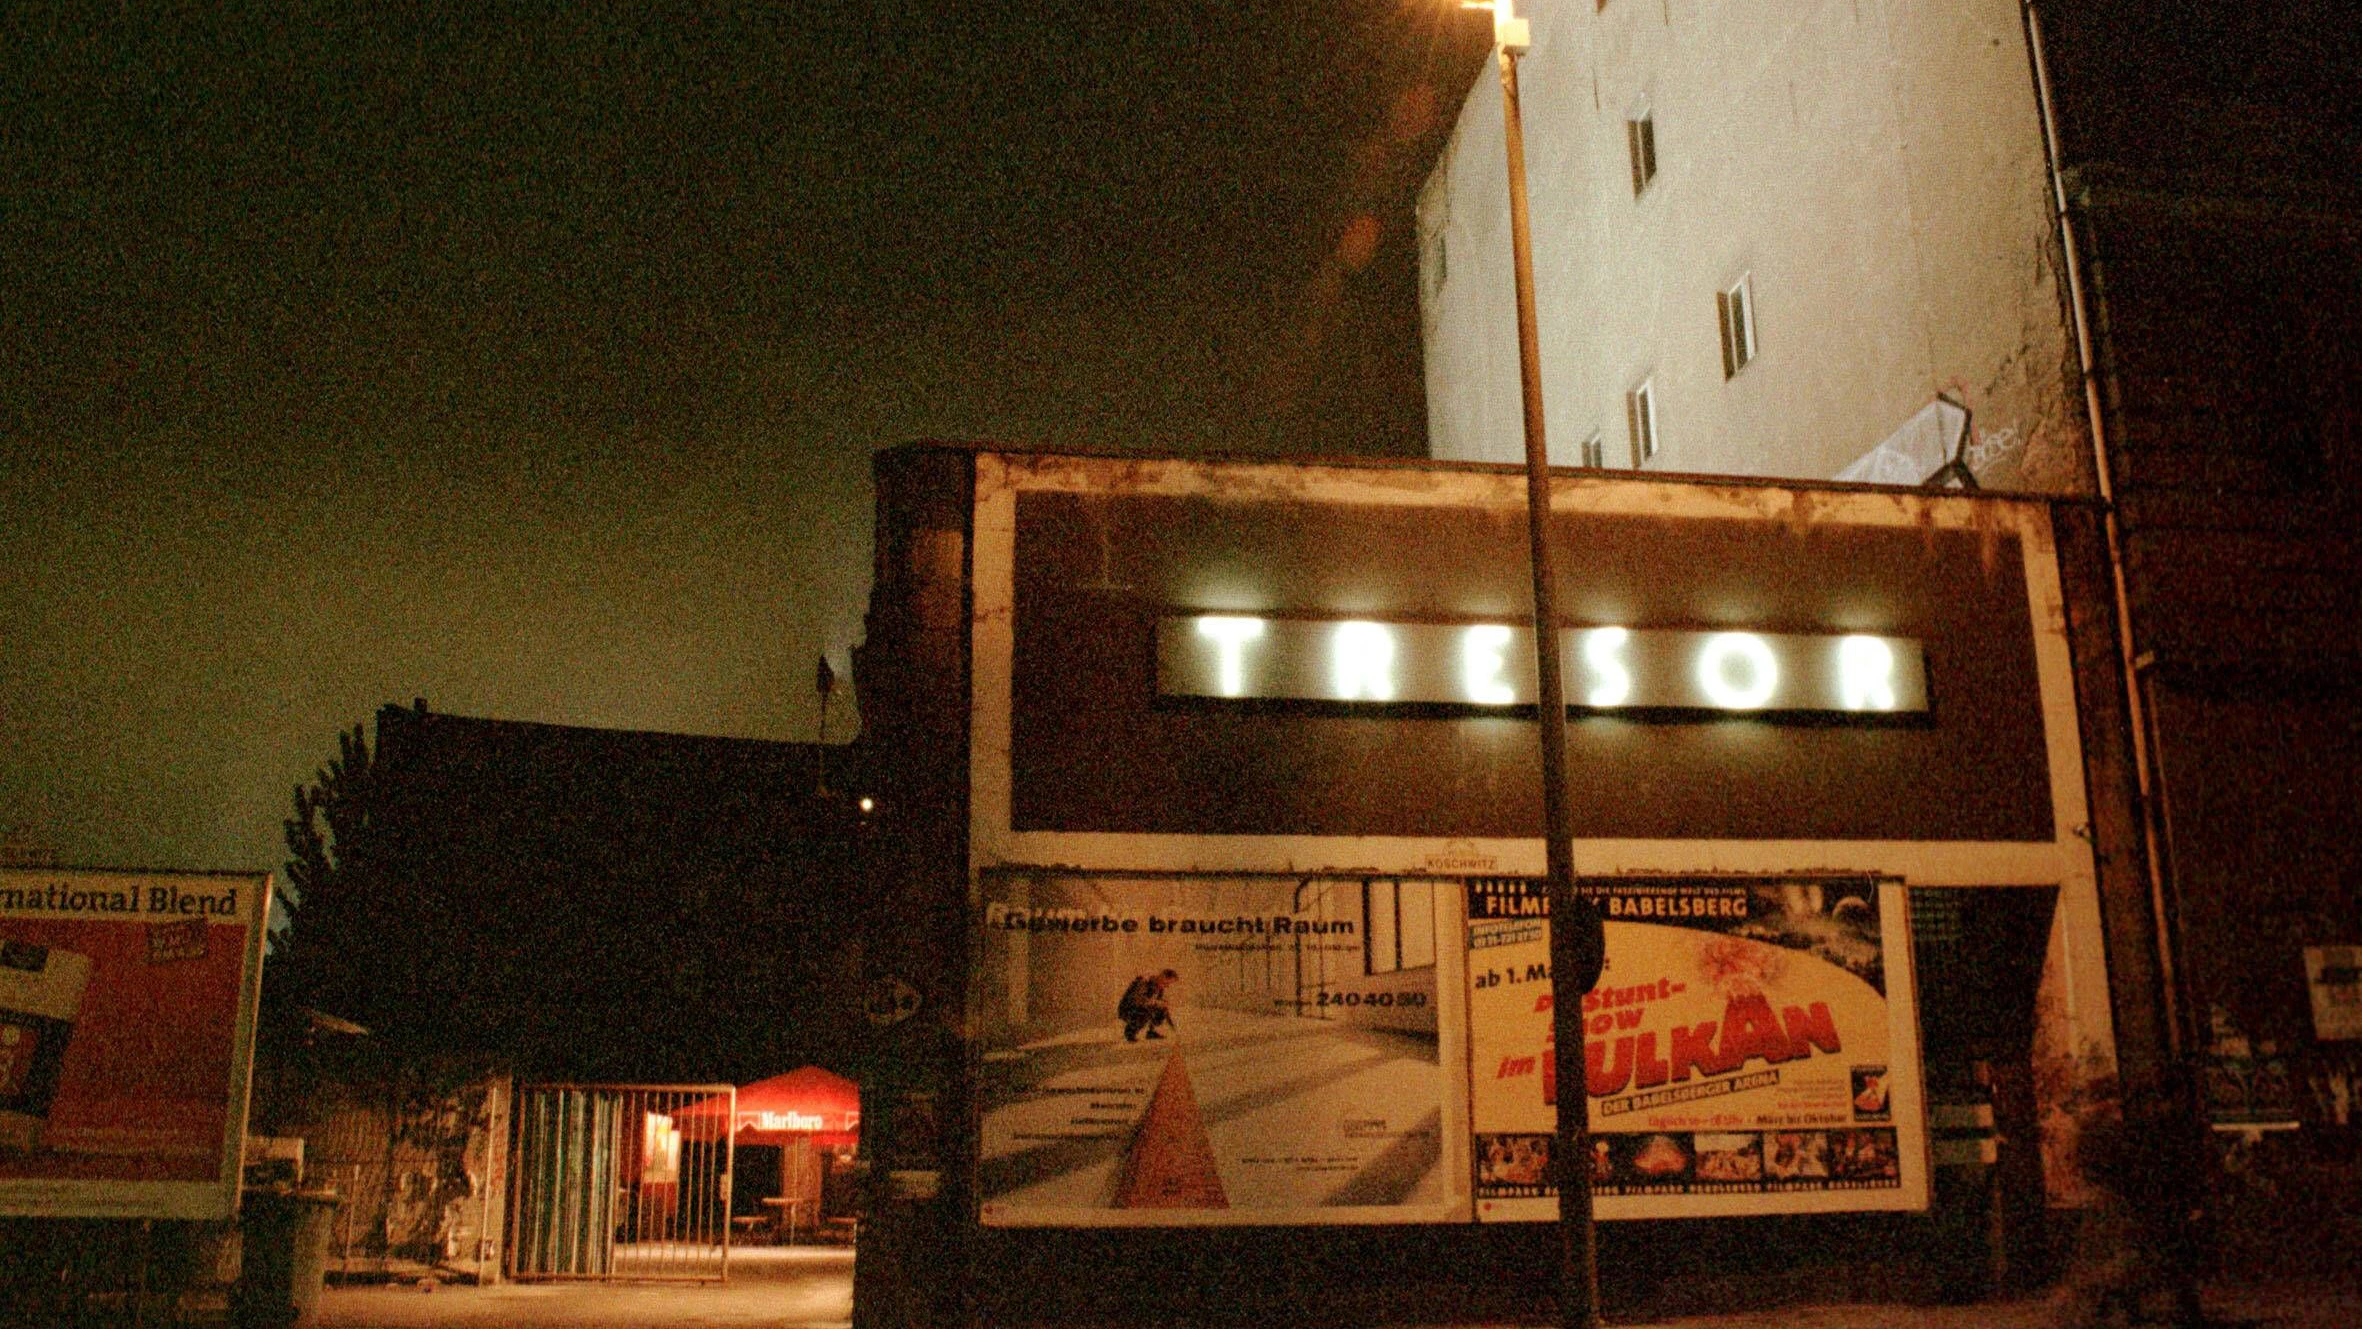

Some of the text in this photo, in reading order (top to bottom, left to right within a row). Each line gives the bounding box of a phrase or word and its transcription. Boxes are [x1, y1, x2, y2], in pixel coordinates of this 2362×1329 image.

[1194, 615, 1897, 712] TRESOR
[0, 883, 237, 917] national Blend
[1608, 896, 1748, 917] BABELSBERG
[1148, 911, 1265, 934] braucht
[1273, 916, 1355, 935] Raum
[1475, 968, 1500, 989] ab
[761, 1110, 824, 1131] Marlboro
